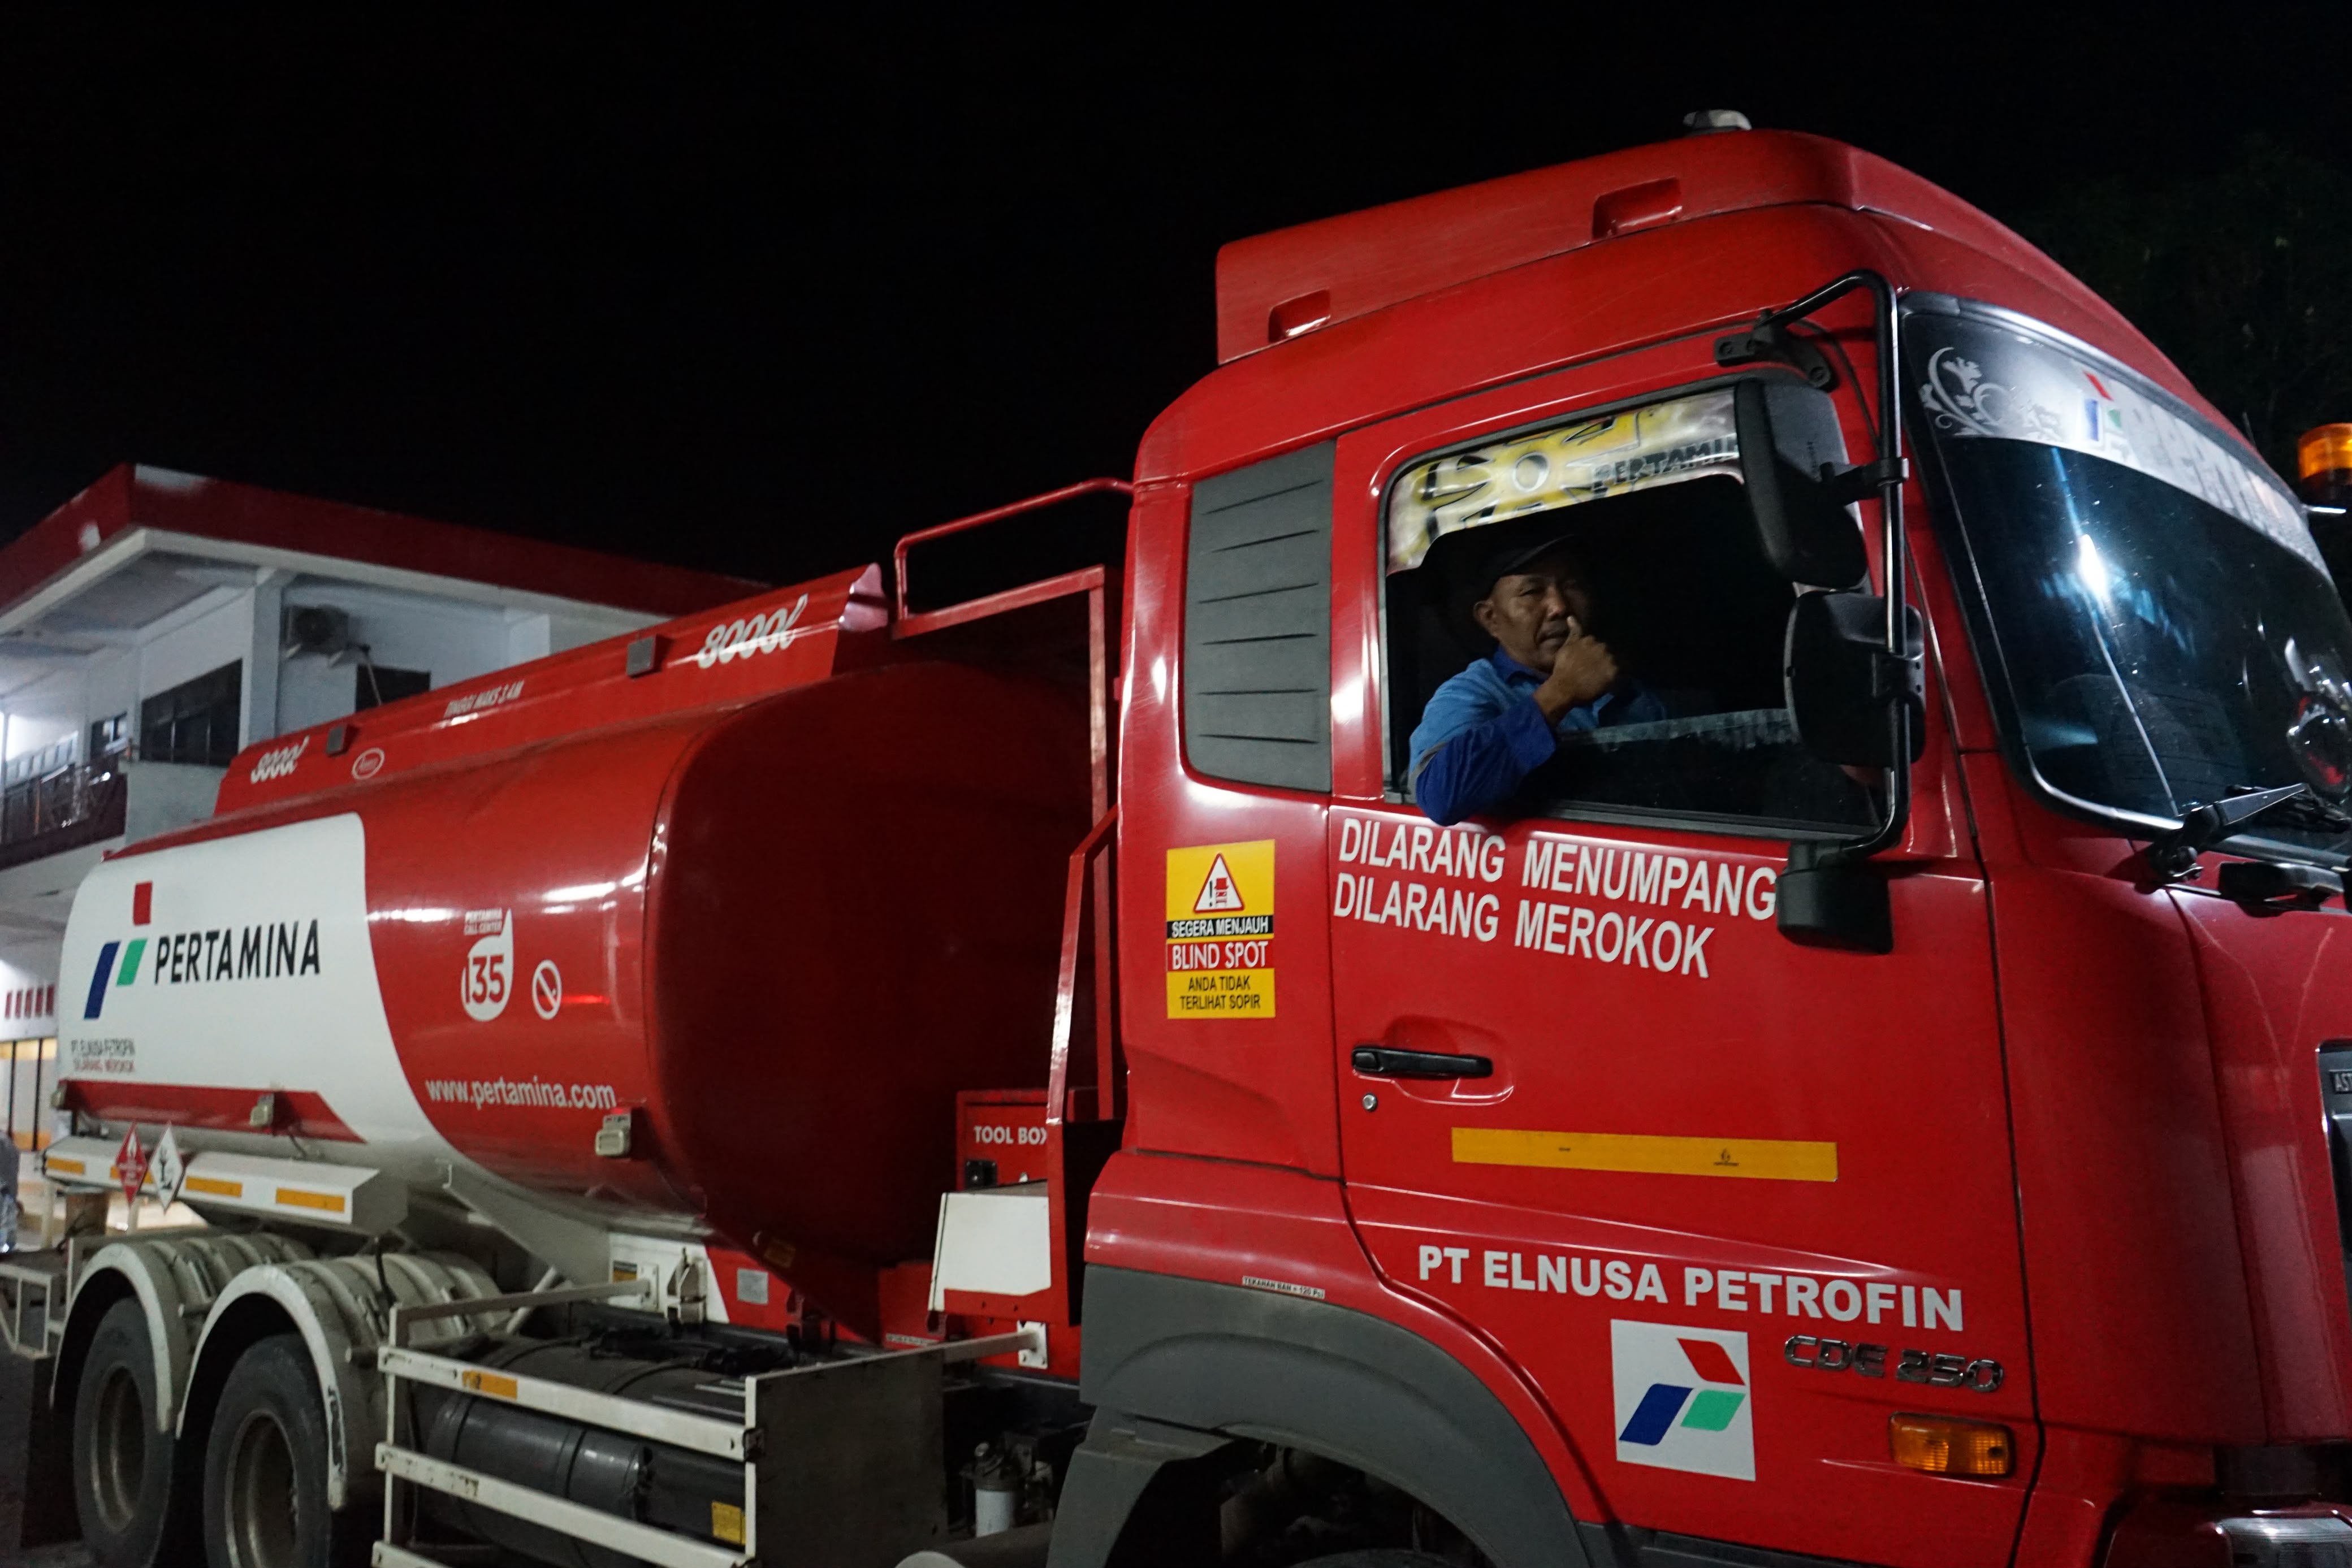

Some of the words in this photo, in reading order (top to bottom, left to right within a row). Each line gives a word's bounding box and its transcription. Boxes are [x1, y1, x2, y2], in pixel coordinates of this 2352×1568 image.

[1339, 818, 1506, 882] DILARANG
[1521, 839, 1778, 921] MENUMPANG
[1172, 919, 1214, 938] SEGERA
[1216, 916, 1268, 935] MENJAUH
[1334, 873, 1500, 942] DILARANG
[1514, 899, 1715, 978] MEROKOK
[154, 919, 320, 984] PERTAMINA
[1172, 944, 1220, 970] BLIND
[1225, 940, 1269, 968] SPOT
[465, 955, 505, 1004] 135
[1188, 976, 1217, 991] ANDA
[1219, 975, 1250, 990] TIDAK
[1179, 995, 1226, 1010] TERLIHAT
[1230, 994, 1260, 1009] SOPIR
[425, 1075, 617, 1111] www.pertamina.com
[974, 1125, 1014, 1144] TOOL
[1419, 1245, 1469, 1283] PT
[1484, 1250, 1668, 1303] ELNUSA
[1684, 1267, 1963, 1332] PETROFIN
[1784, 1334, 1888, 1378] CDE
[1896, 1348, 2004, 1393] 250
